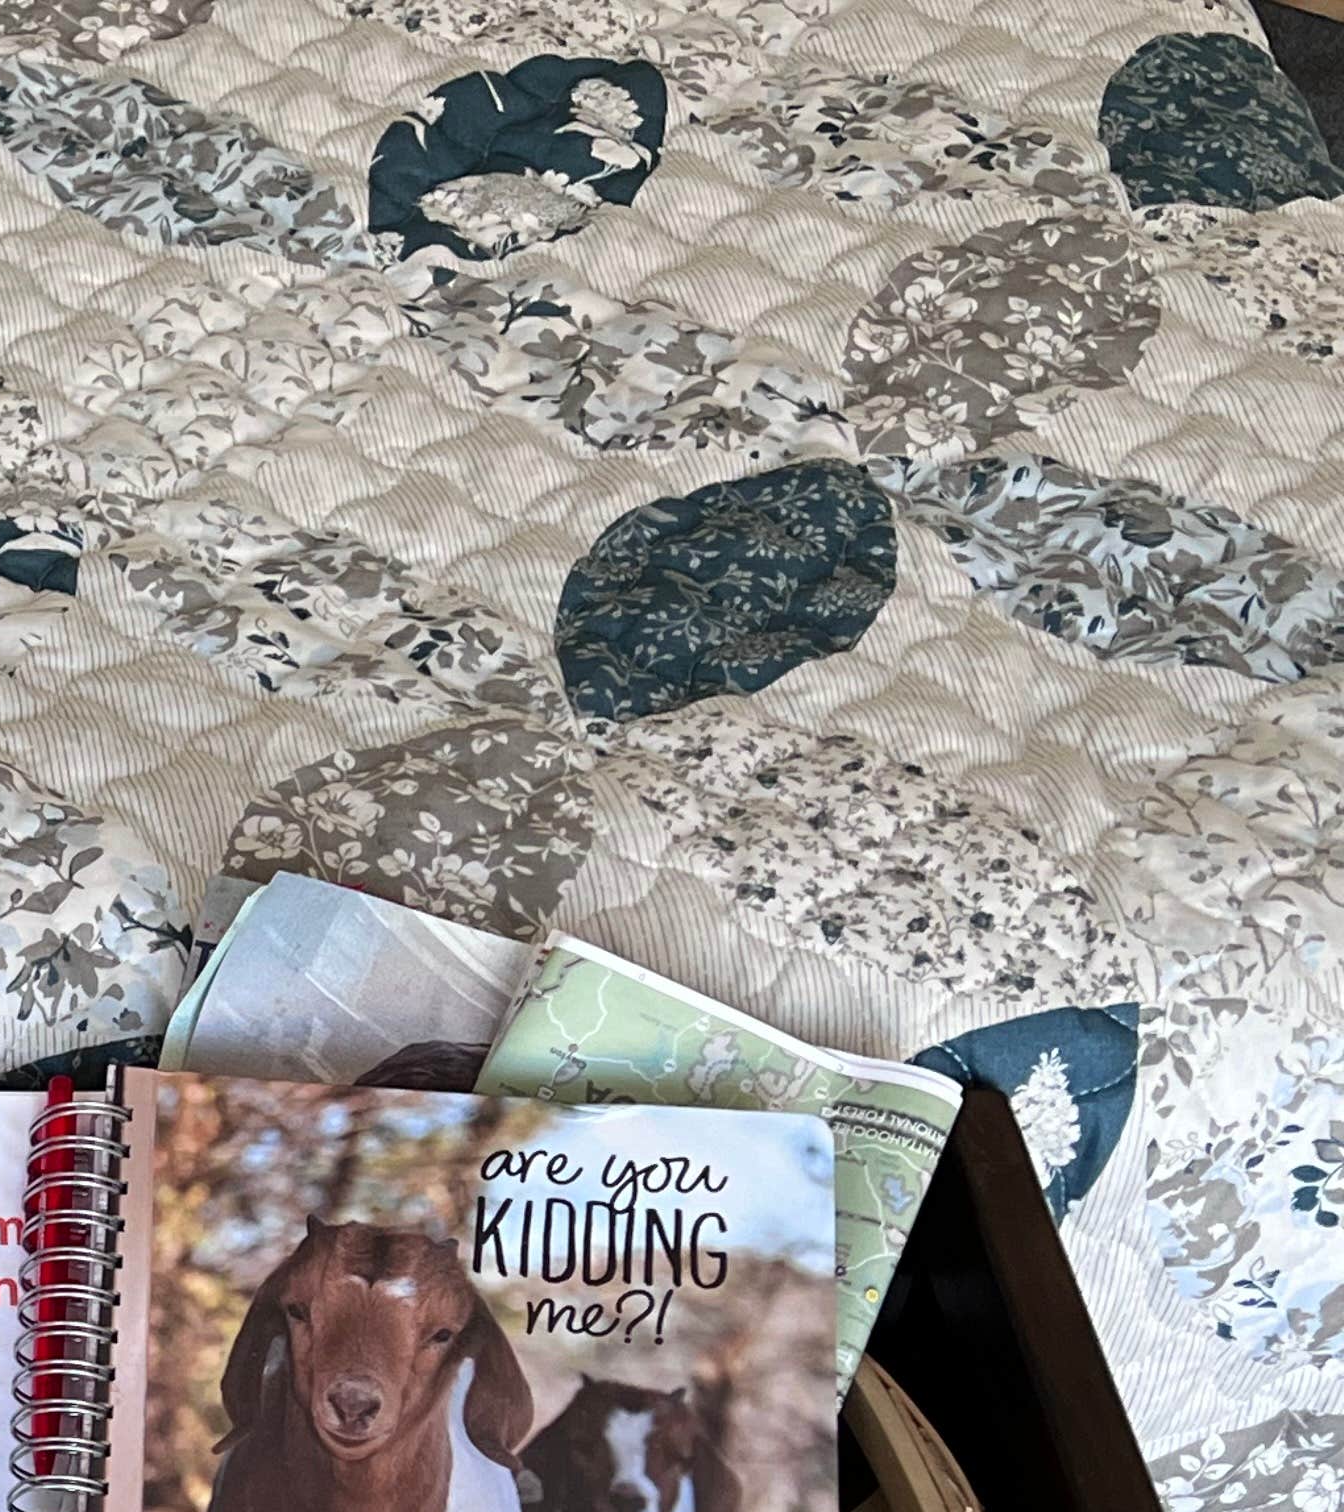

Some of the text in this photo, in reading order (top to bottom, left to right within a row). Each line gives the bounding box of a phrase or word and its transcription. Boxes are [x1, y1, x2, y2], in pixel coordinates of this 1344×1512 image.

[890, 1114, 946, 1146] ATIONAL
[480, 1149, 728, 1215] are you
[472, 1195, 728, 1290] KIDDING
[526, 1289, 674, 1345] me?!
